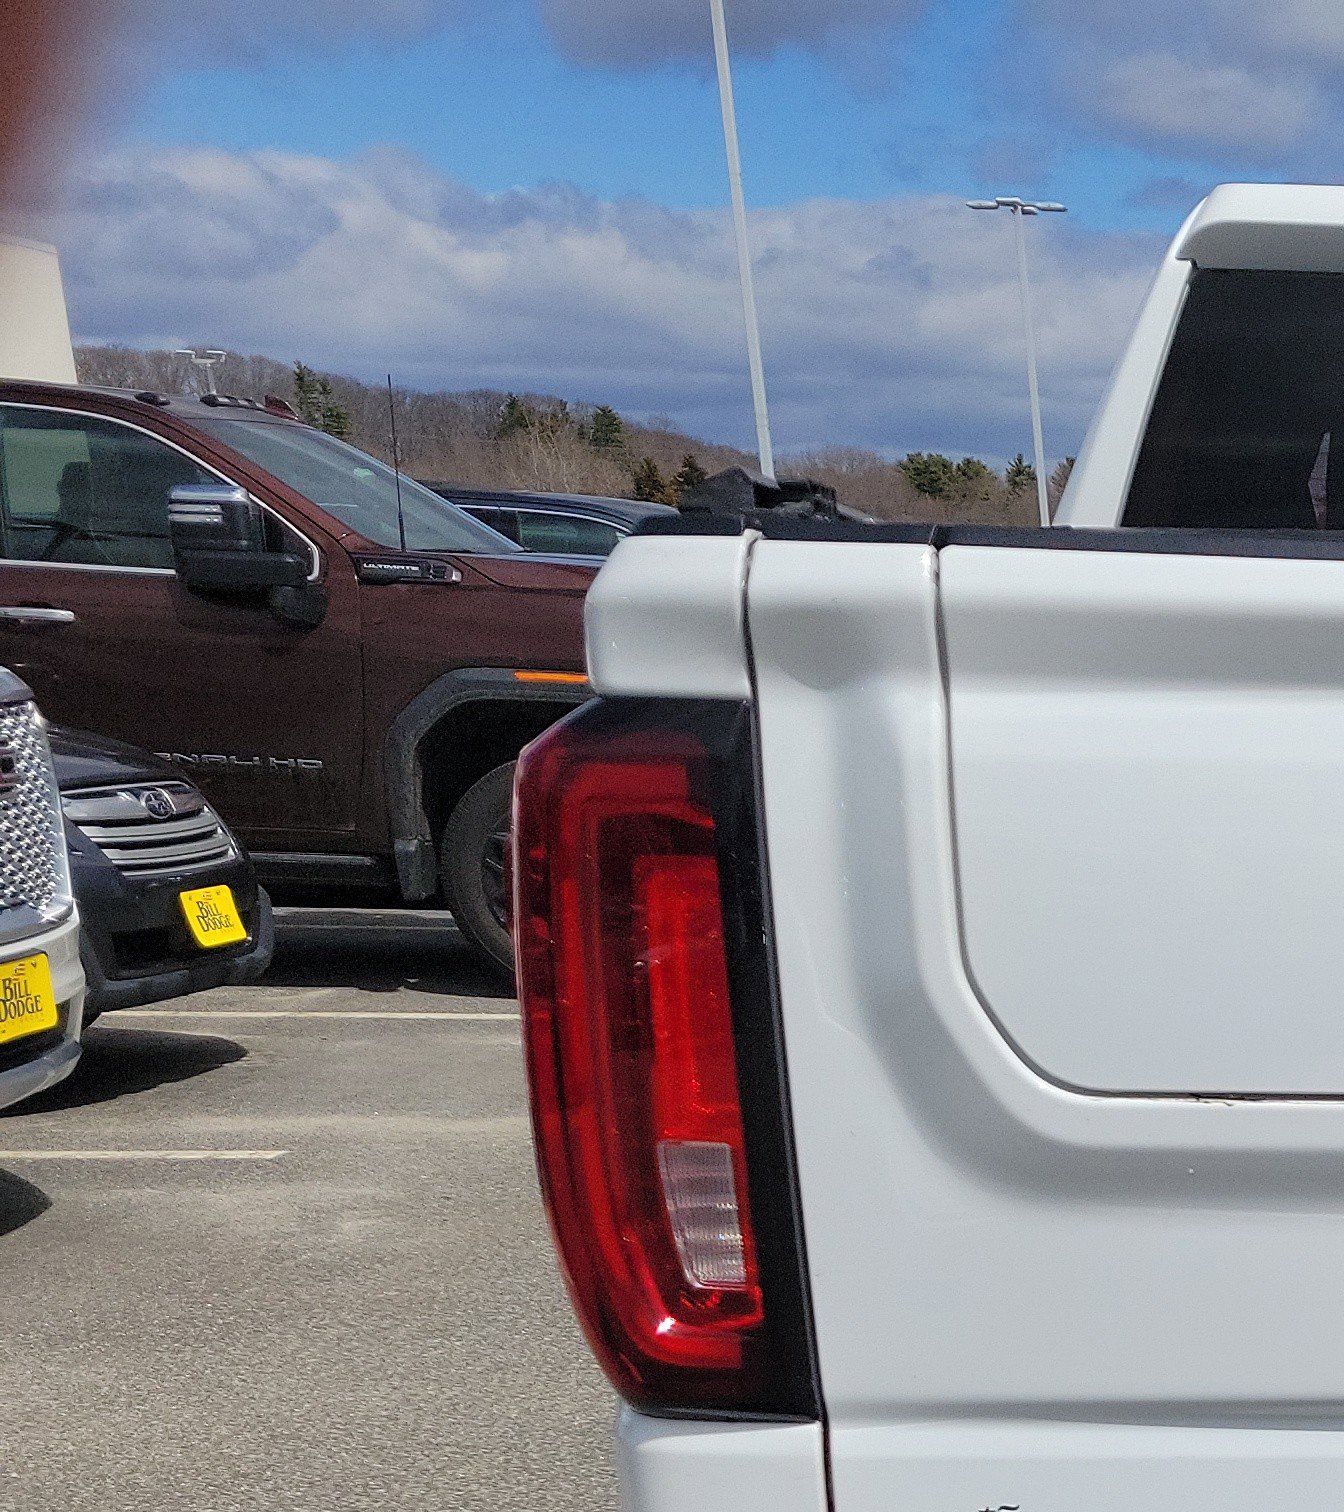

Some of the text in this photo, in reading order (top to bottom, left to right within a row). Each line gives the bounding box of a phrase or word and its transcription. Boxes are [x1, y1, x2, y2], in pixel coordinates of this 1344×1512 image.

[269, 757, 323, 769] HD
[196, 900, 222, 918] BILL
[196, 913, 234, 932] DODGE
[2, 977, 31, 1002] BILL
